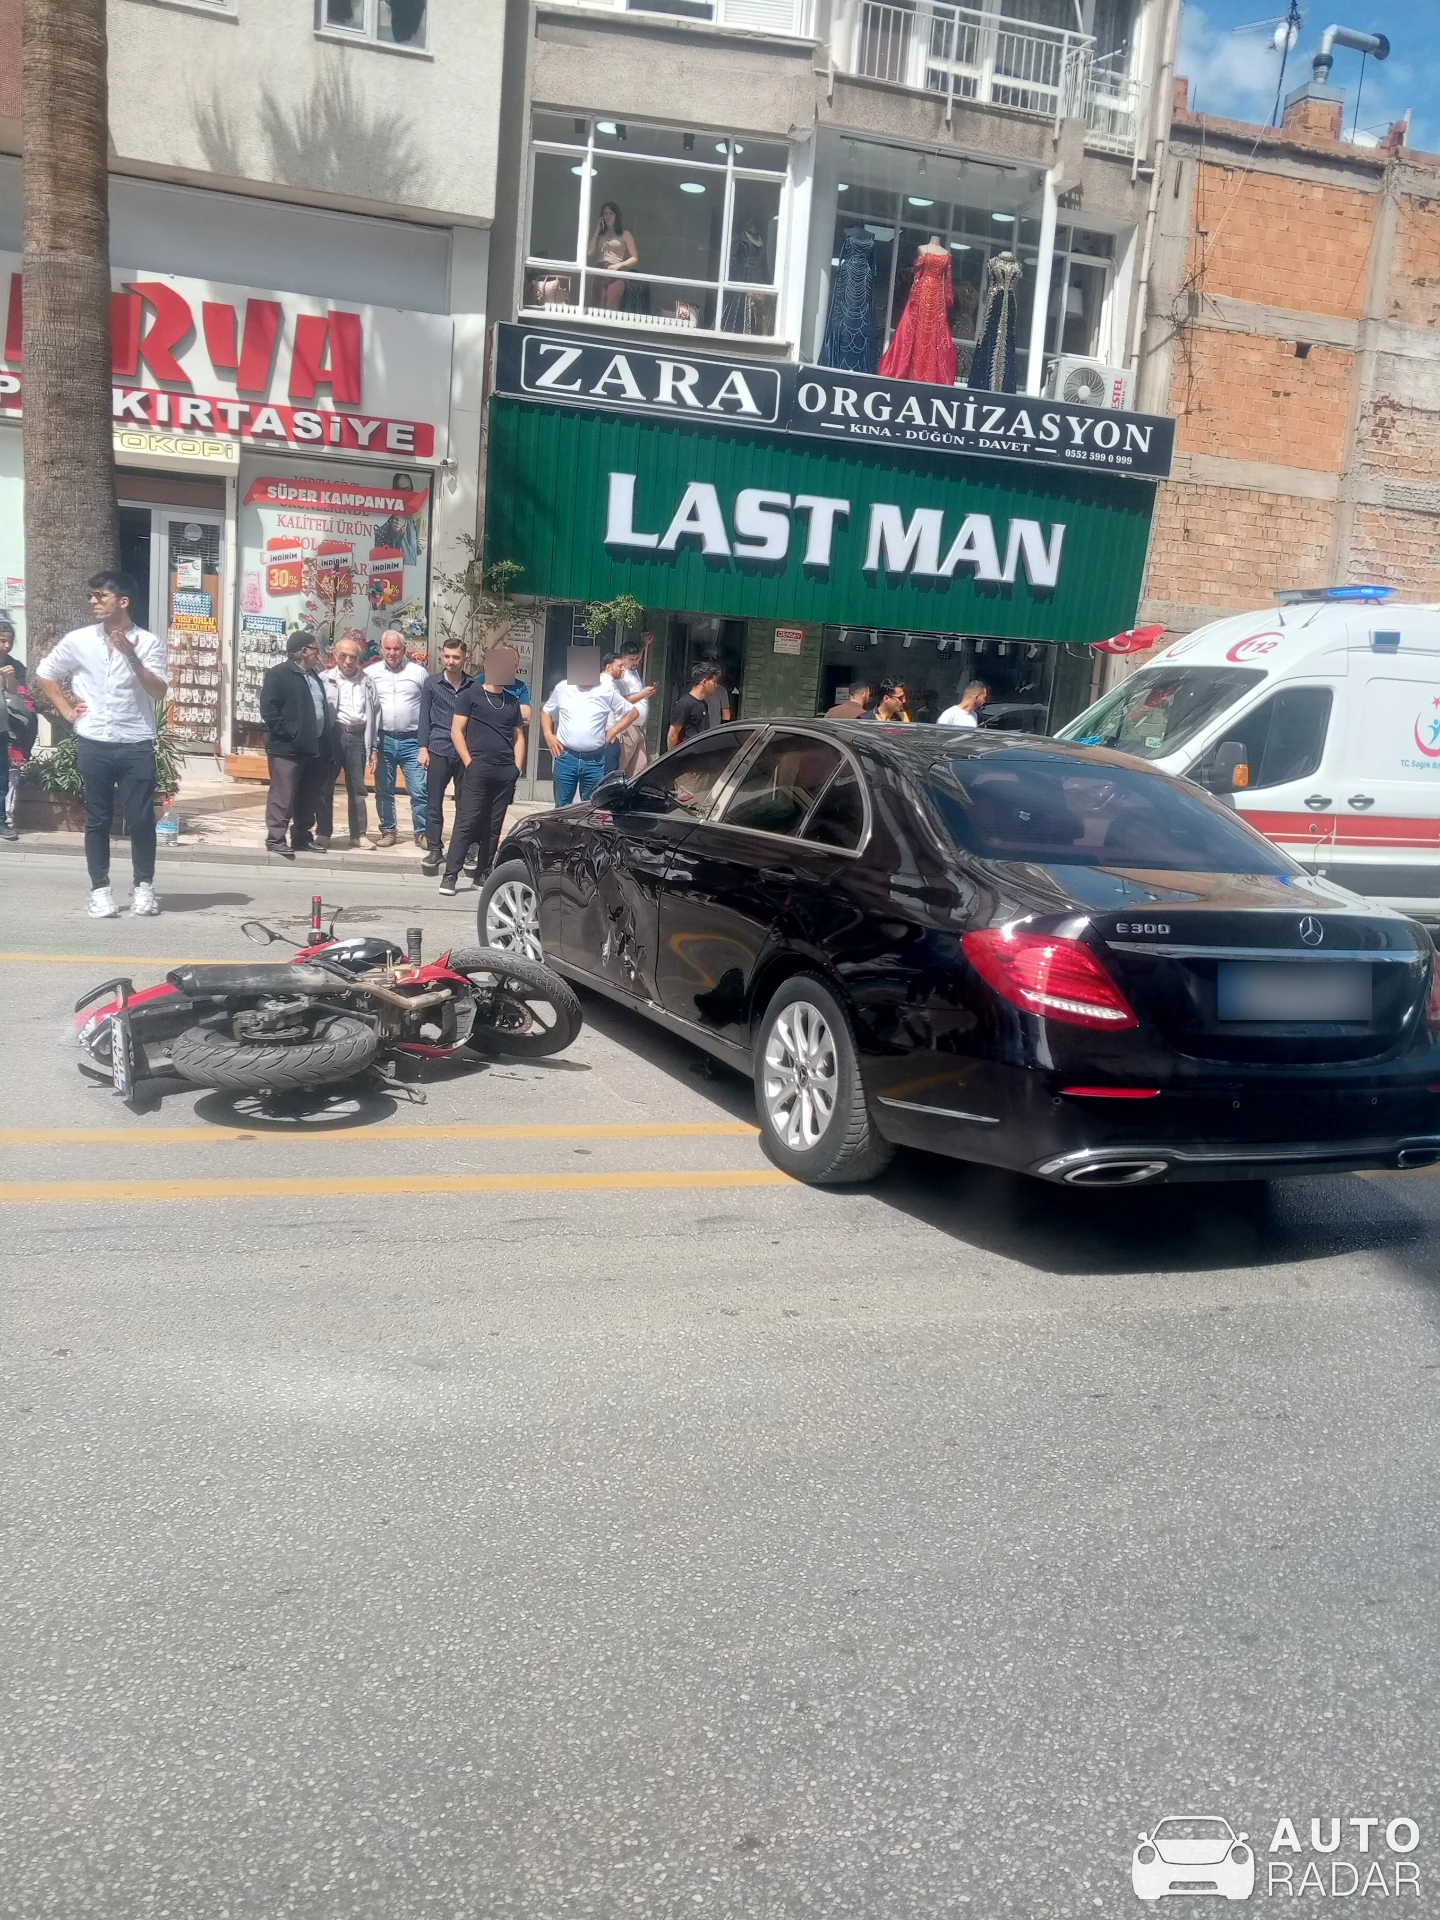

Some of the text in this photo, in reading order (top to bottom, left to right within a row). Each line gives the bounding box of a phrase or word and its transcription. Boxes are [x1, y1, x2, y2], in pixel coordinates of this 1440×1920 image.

[535, 344, 762, 416] ZARA
[1111, 378, 1123, 409] ESTEL
[799, 383, 1153, 453] ORGANİZASYON
[850, 423, 1031, 452] KINA DÜĞÜN DAVET
[1065, 448, 1133, 465] 0552 599 0 999
[267, 483, 318, 503] SÜPER
[321, 491, 405, 512] KAMPANYA
[276, 514, 374, 538] KALİTELİ ÜRÜN
[605, 472, 1066, 588] LAST MAN
[270, 552, 298, 564] İNDİRİM
[372, 562, 400, 572] İNDİRİM
[1241, 640, 1279, 654] 112
